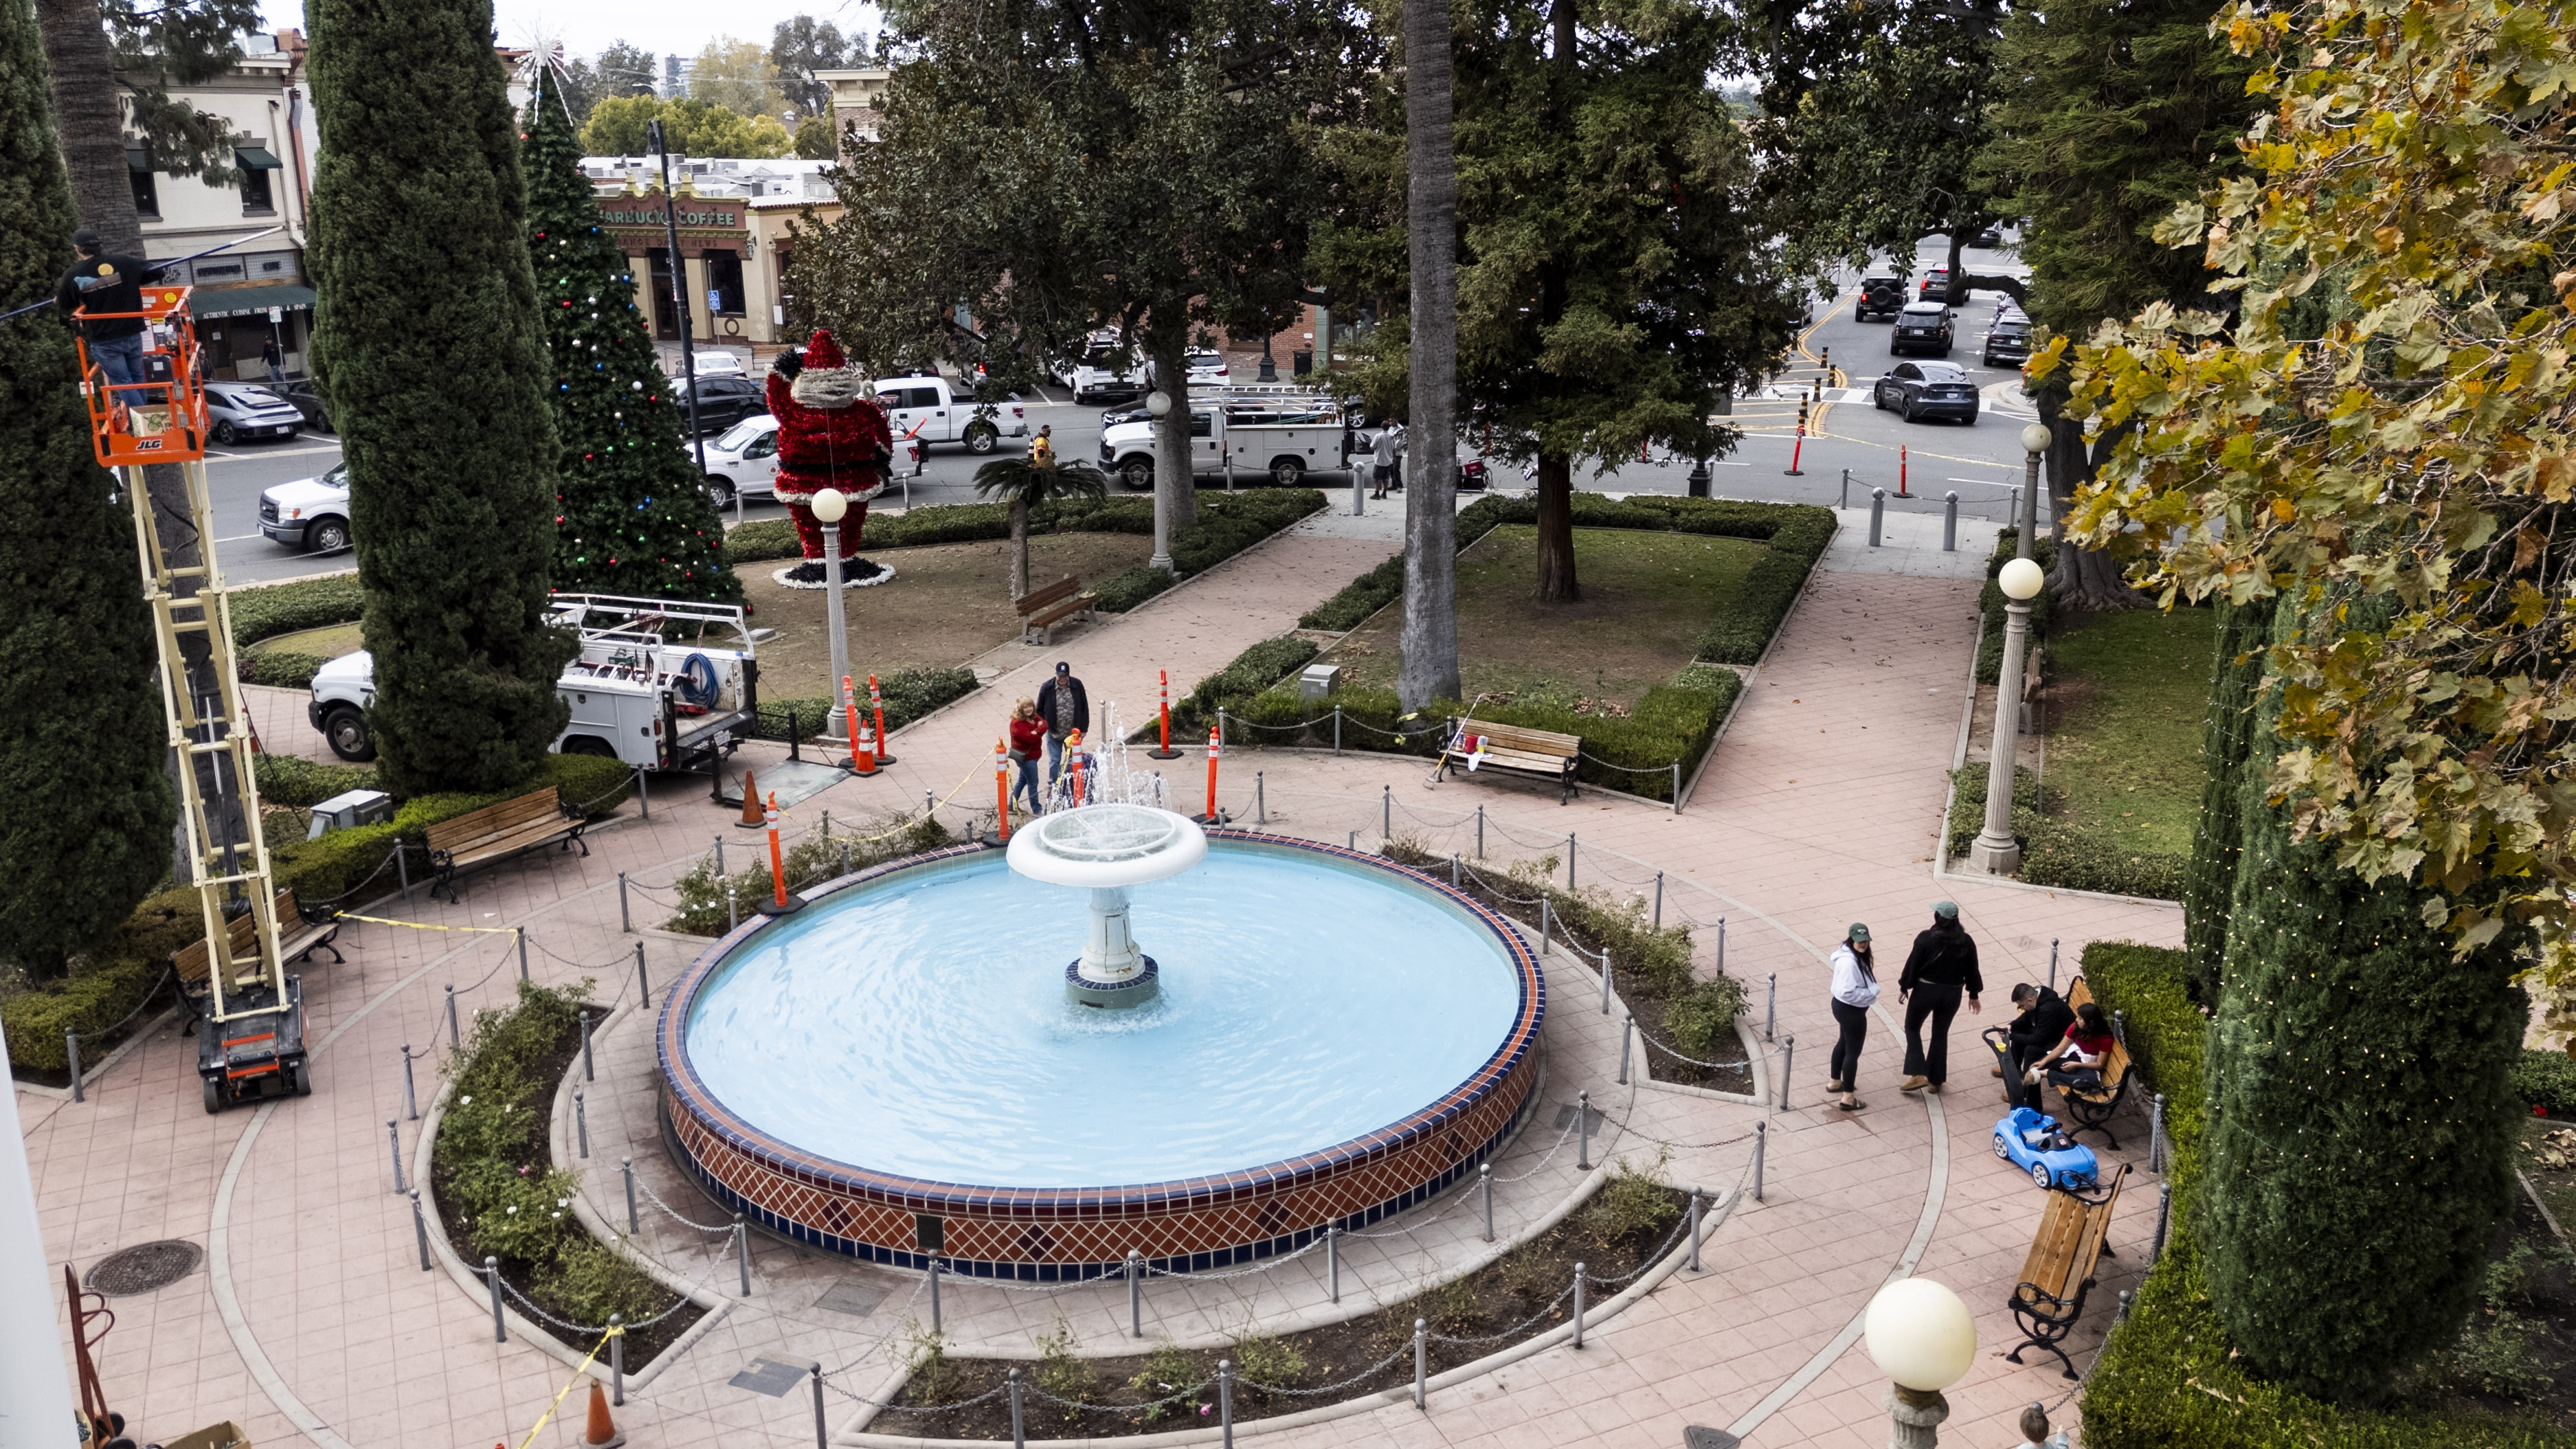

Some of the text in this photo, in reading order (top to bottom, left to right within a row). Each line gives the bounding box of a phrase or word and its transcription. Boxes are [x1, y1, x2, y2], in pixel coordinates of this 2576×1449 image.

[603, 210, 735, 226] ARBUCK COFFEE
[691, 239, 717, 247] NEWS
[203, 311, 229, 319] AUTHENTIC
[232, 308, 251, 316] CUISINE
[136, 439, 162, 450] JLG
